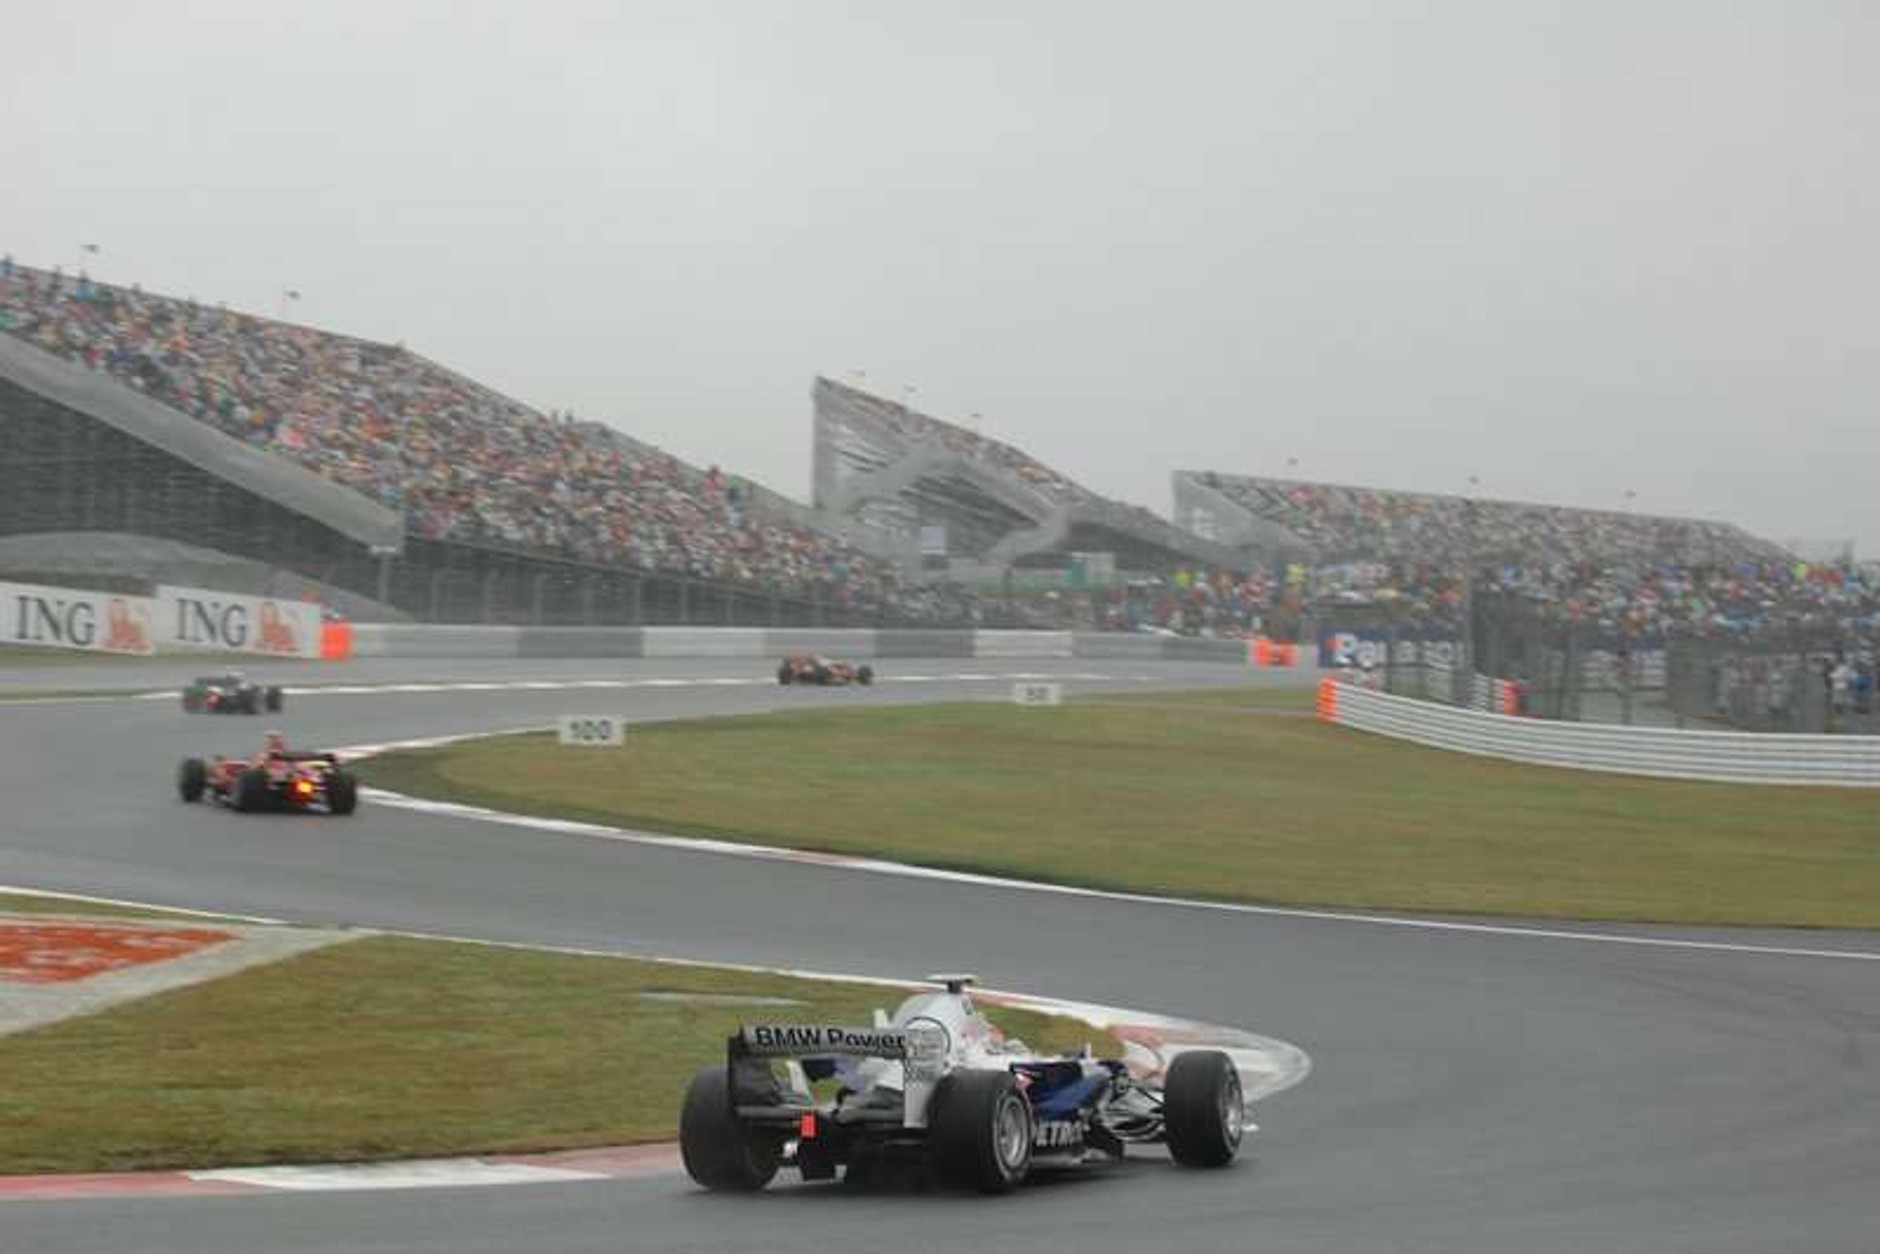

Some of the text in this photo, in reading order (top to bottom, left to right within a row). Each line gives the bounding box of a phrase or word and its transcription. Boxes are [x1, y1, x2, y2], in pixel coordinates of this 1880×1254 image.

[16, 595, 95, 646] ING
[175, 598, 247, 647] ING
[568, 719, 613, 741] 100
[755, 1027, 906, 1049] BMW Power
